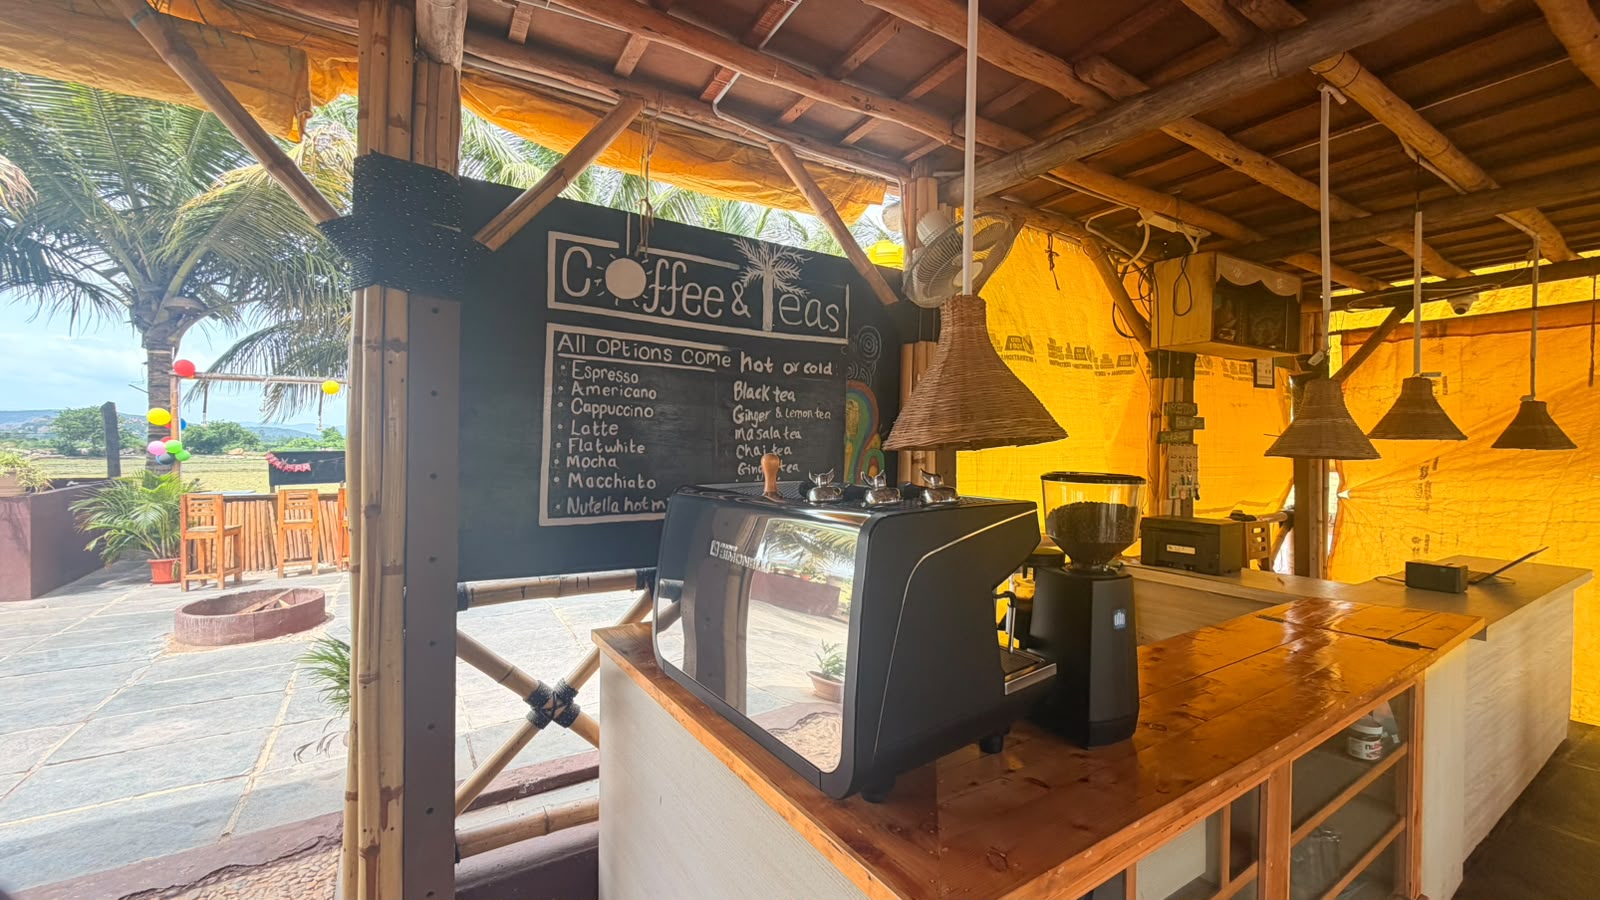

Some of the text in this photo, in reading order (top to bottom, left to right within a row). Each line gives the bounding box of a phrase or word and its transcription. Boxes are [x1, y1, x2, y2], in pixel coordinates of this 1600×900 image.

[731, 280, 751, 318] &
[557, 334, 586, 353] All
[740, 351, 774, 373] hot
[783, 361, 800, 375] or
[803, 361, 833, 375] cold
[571, 360, 639, 383] Espresso
[571, 381, 657, 400] Americano
[733, 380, 796, 403] Black tea
[570, 397, 655, 419] Cappuccino
[732, 404, 771, 428] Ginger
[775, 406, 783, 418] &
[814, 406, 832, 420] tea
[570, 419, 619, 437] Latte
[782, 425, 802, 440] tea
[771, 443, 793, 456] tea
[566, 454, 619, 469] Mocha
[778, 459, 801, 473] tea
[567, 472, 657, 490] Macchiato
[566, 495, 669, 515] Nutella hot m
[719, 548, 771, 574] SIMONE
